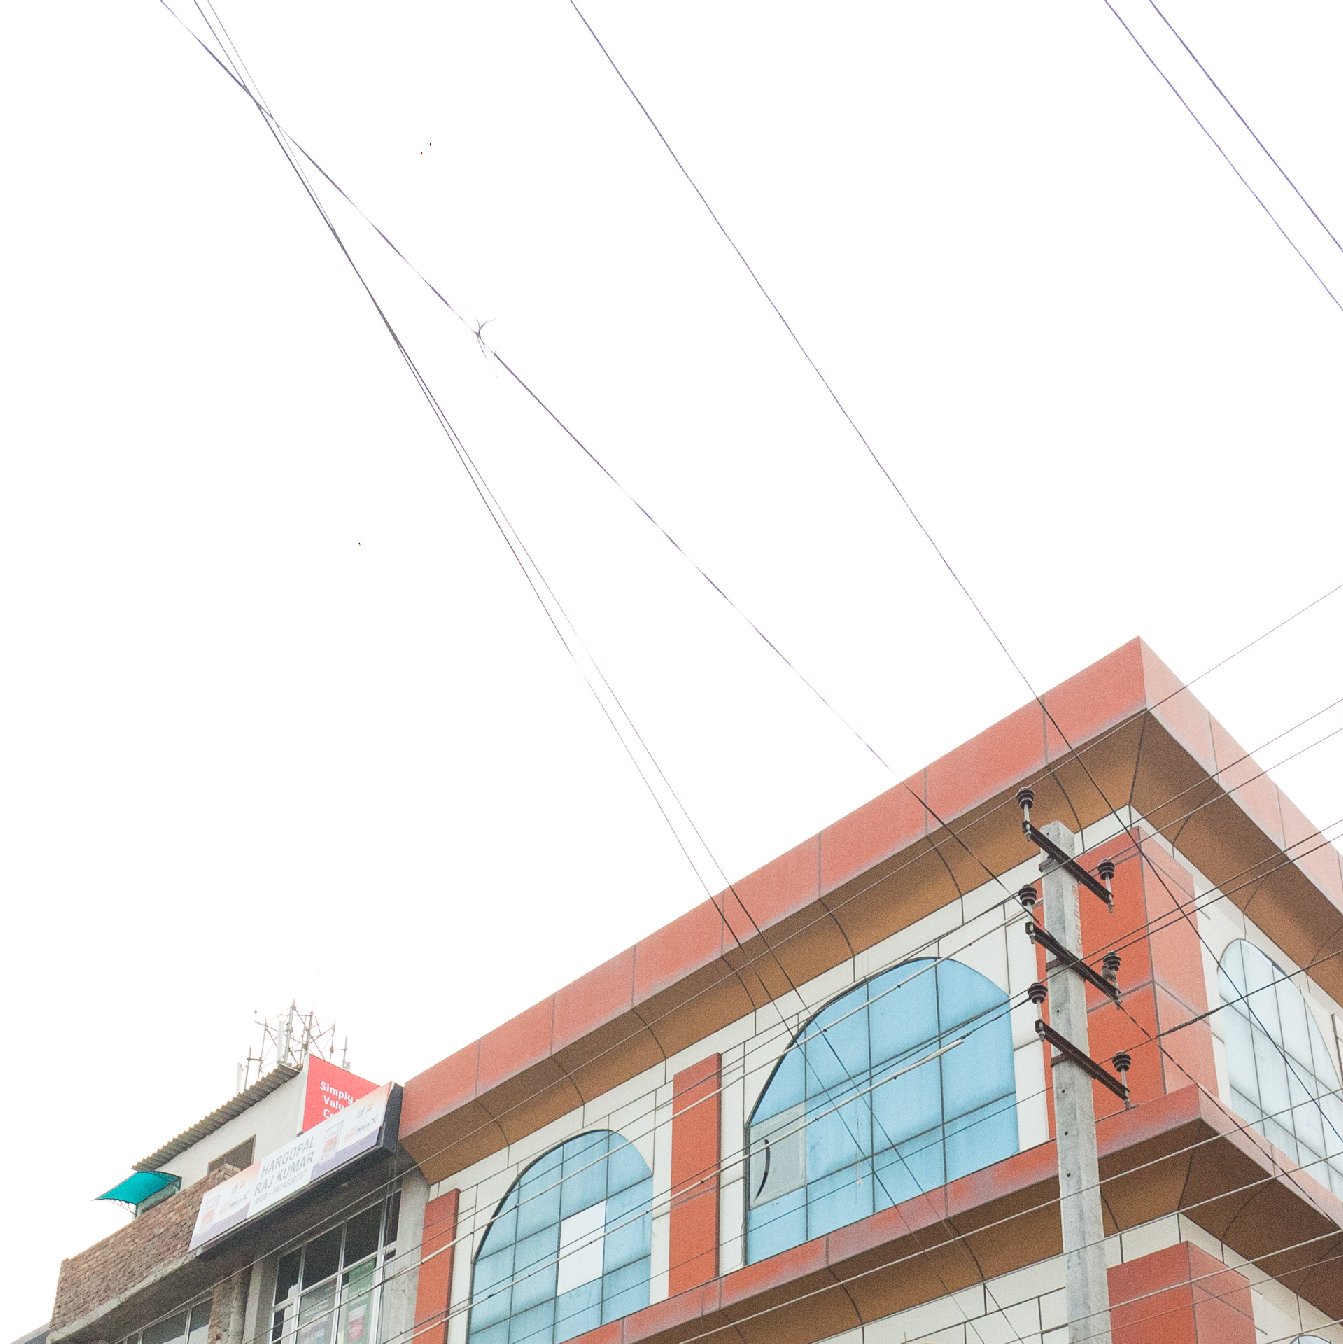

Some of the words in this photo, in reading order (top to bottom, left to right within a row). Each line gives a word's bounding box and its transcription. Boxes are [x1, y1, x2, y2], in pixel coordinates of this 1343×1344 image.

[320, 1081, 354, 1103] Simply
[255, 1176, 274, 1195] RAJ
[276, 1151, 315, 1184] KUMAR
[261, 1136, 315, 1176] HARGOPAL
